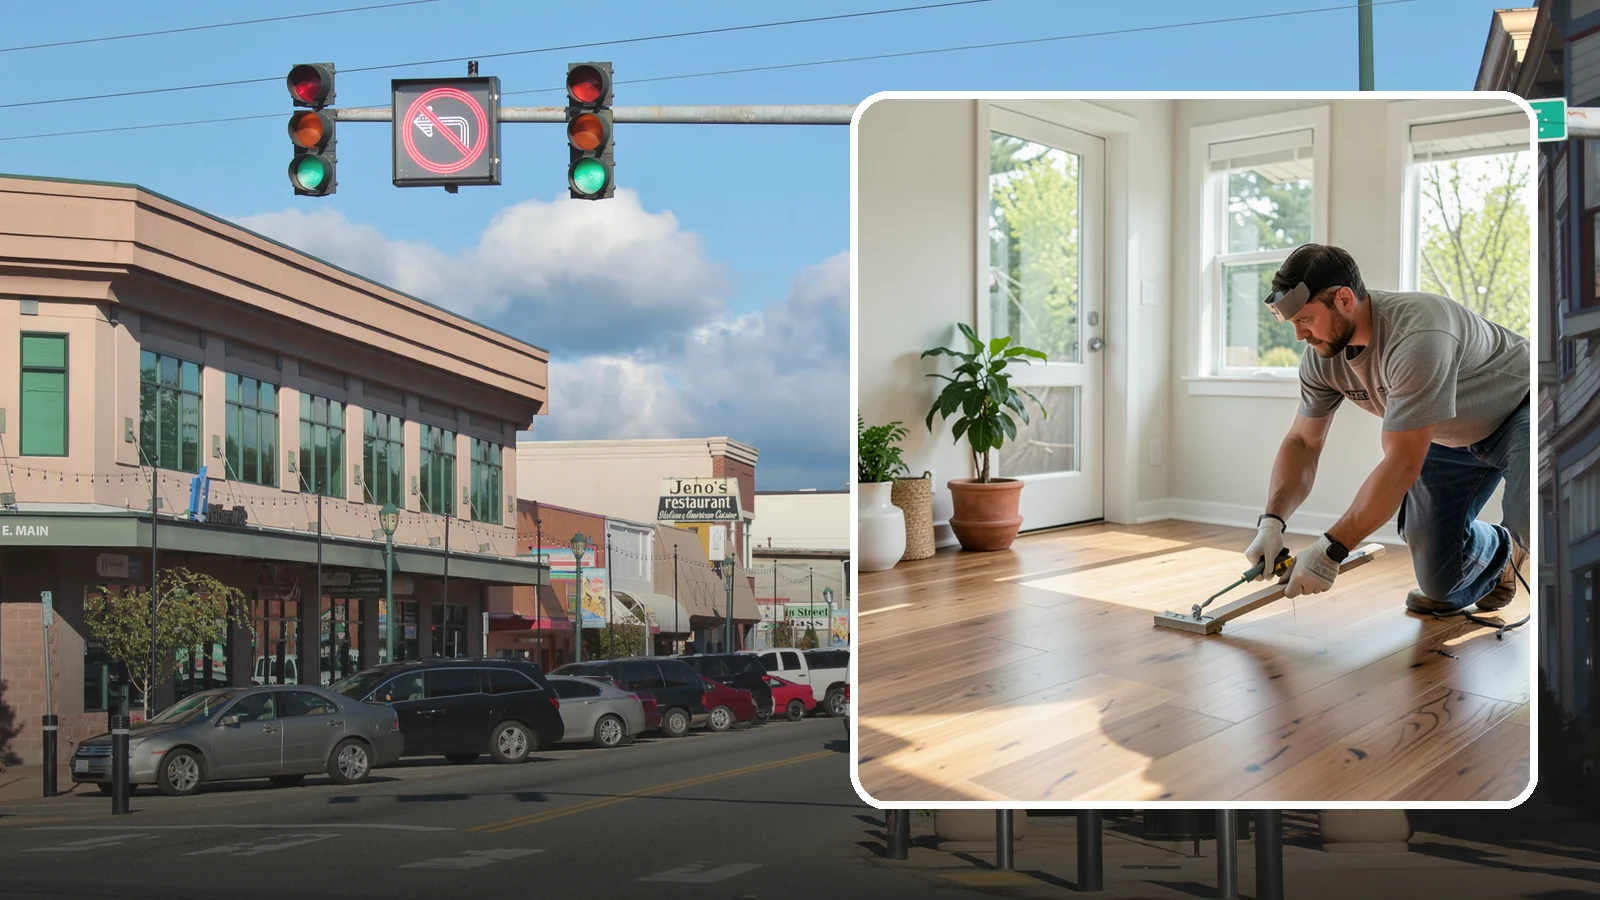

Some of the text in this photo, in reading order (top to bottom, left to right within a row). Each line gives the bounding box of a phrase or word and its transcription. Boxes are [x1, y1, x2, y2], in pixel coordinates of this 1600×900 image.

[669, 480, 727, 495] Jeno's
[665, 496, 731, 509] restaurant
[686, 509, 714, 519] American
[715, 509, 738, 519] Cuisine
[2, 525, 49, 536] E. MAIN
[797, 607, 828, 617] Street
